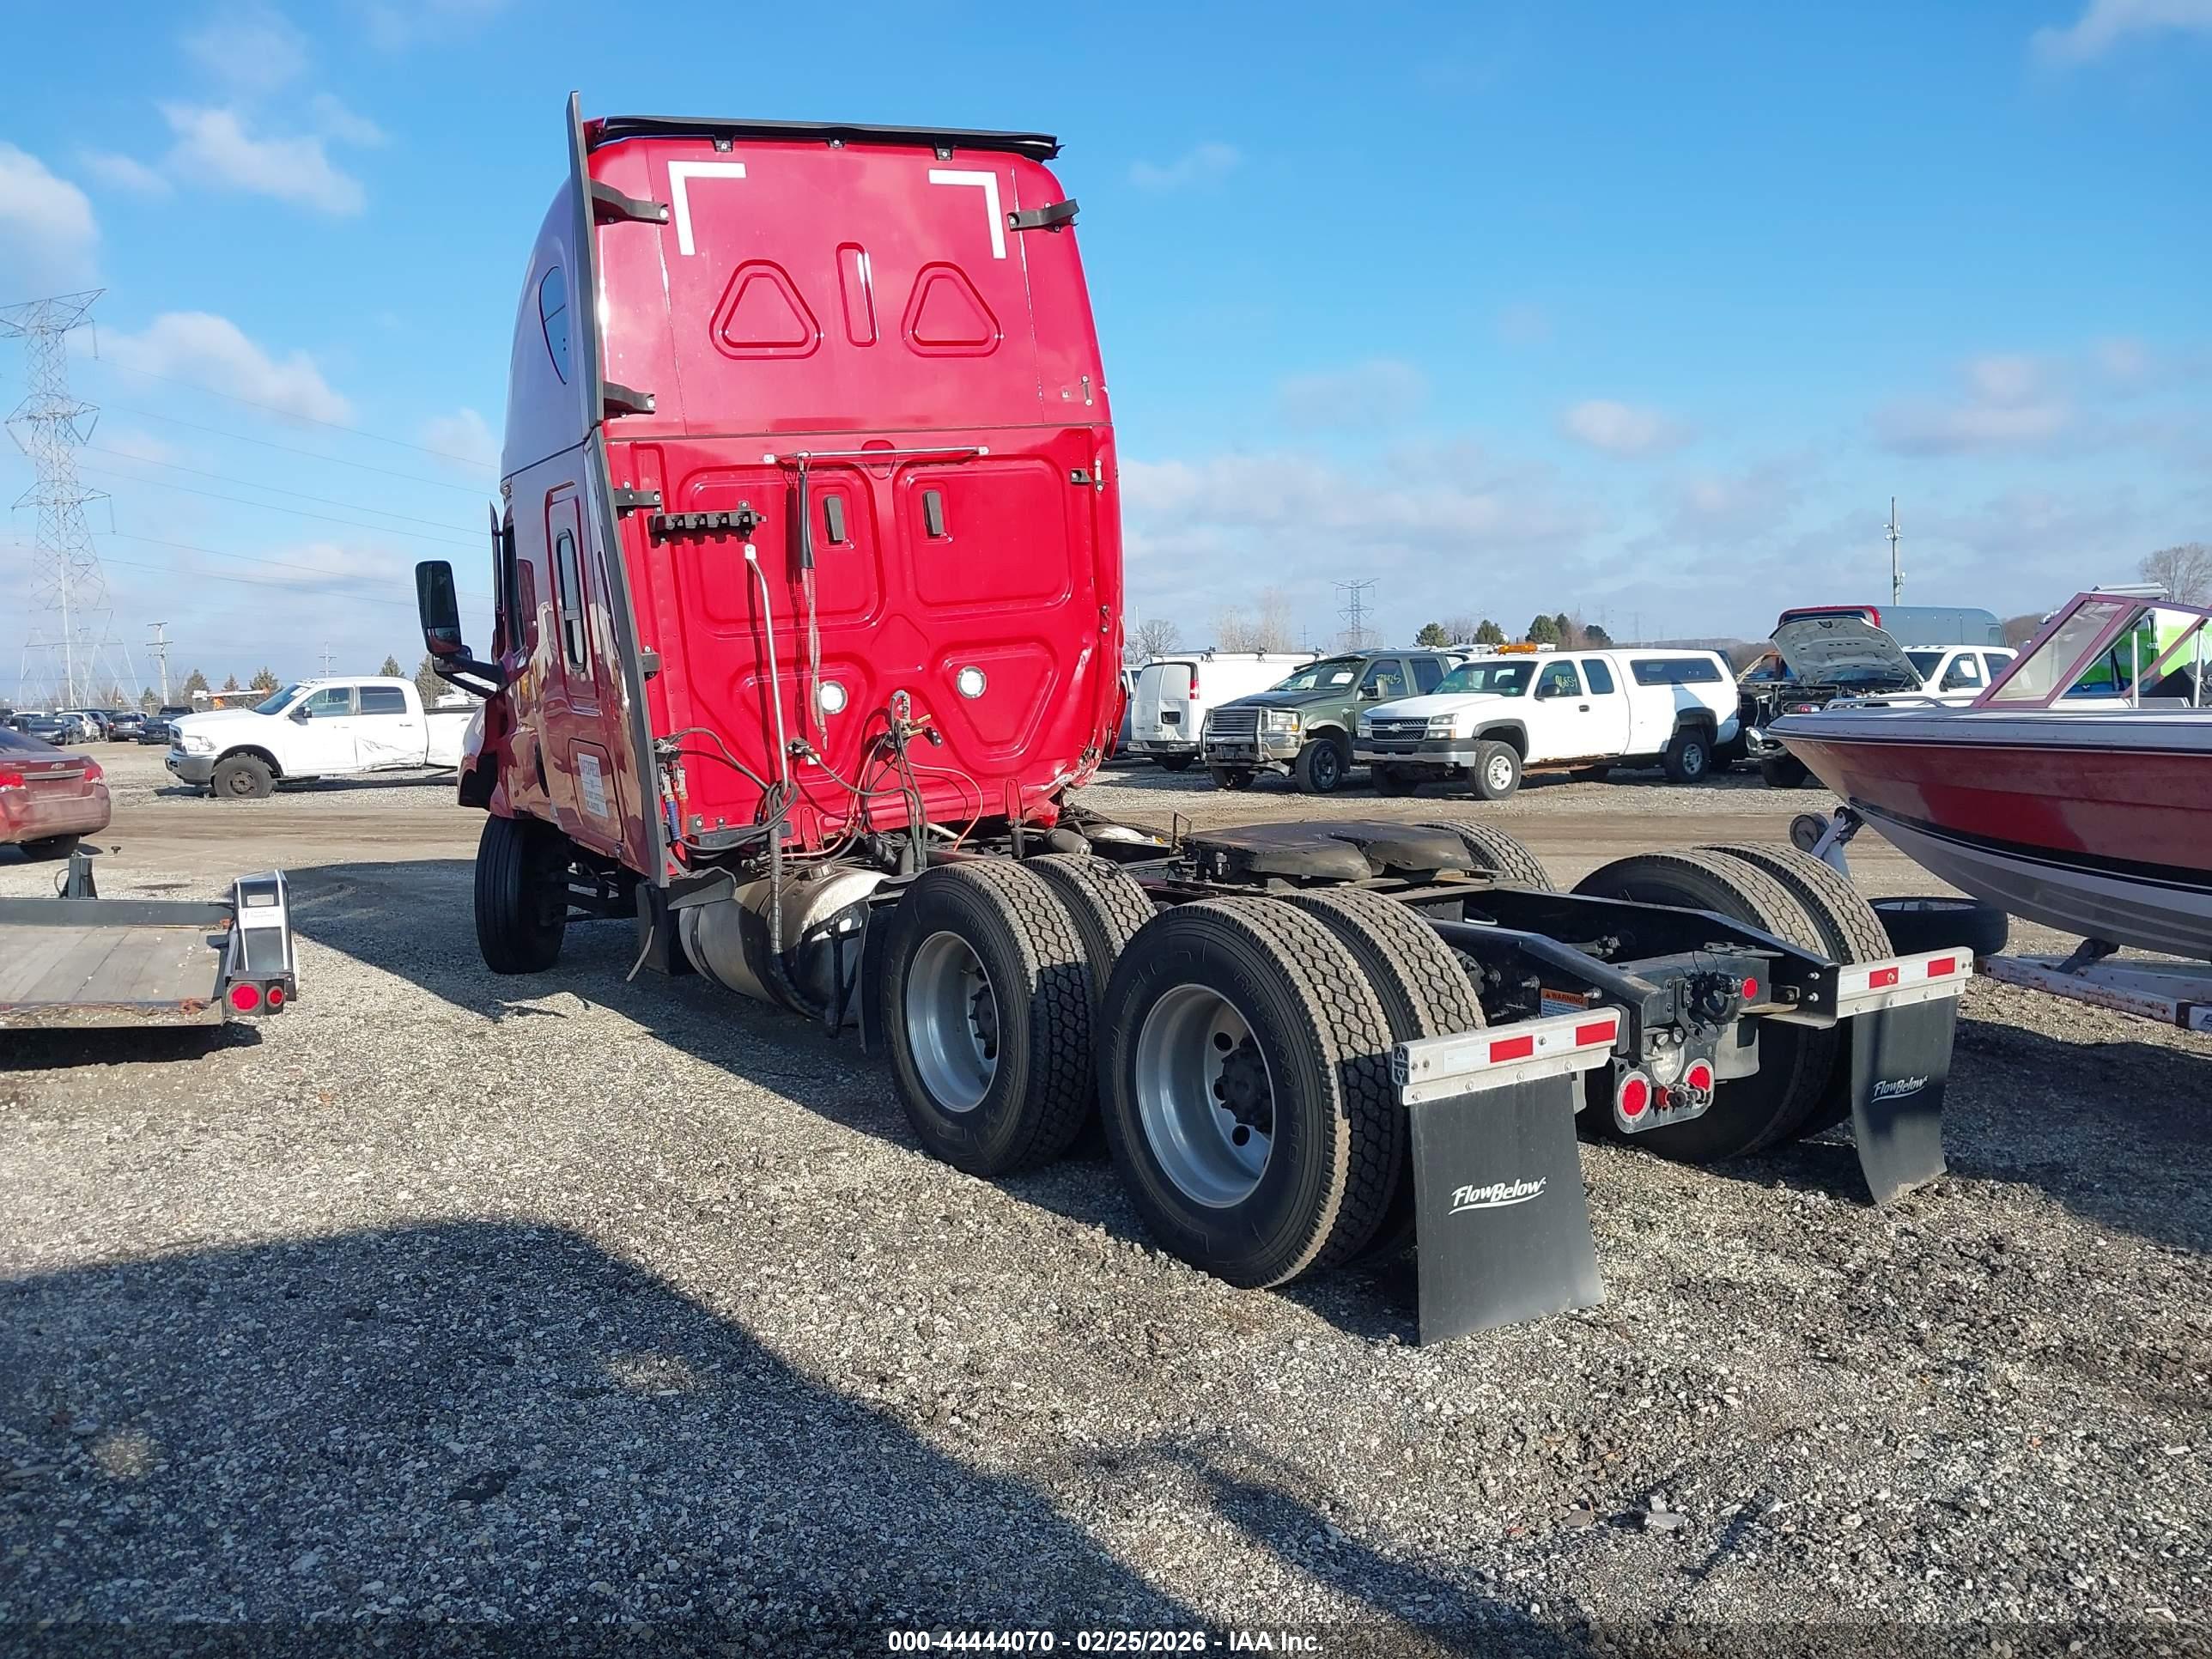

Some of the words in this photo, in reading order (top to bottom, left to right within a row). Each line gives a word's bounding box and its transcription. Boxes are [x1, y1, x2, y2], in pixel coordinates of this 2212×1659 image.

[1551, 992, 1583, 1004] WARNING
[1874, 1075, 1929, 1097] FlowBelow
[1451, 1176, 1547, 1207] FlowBelow
